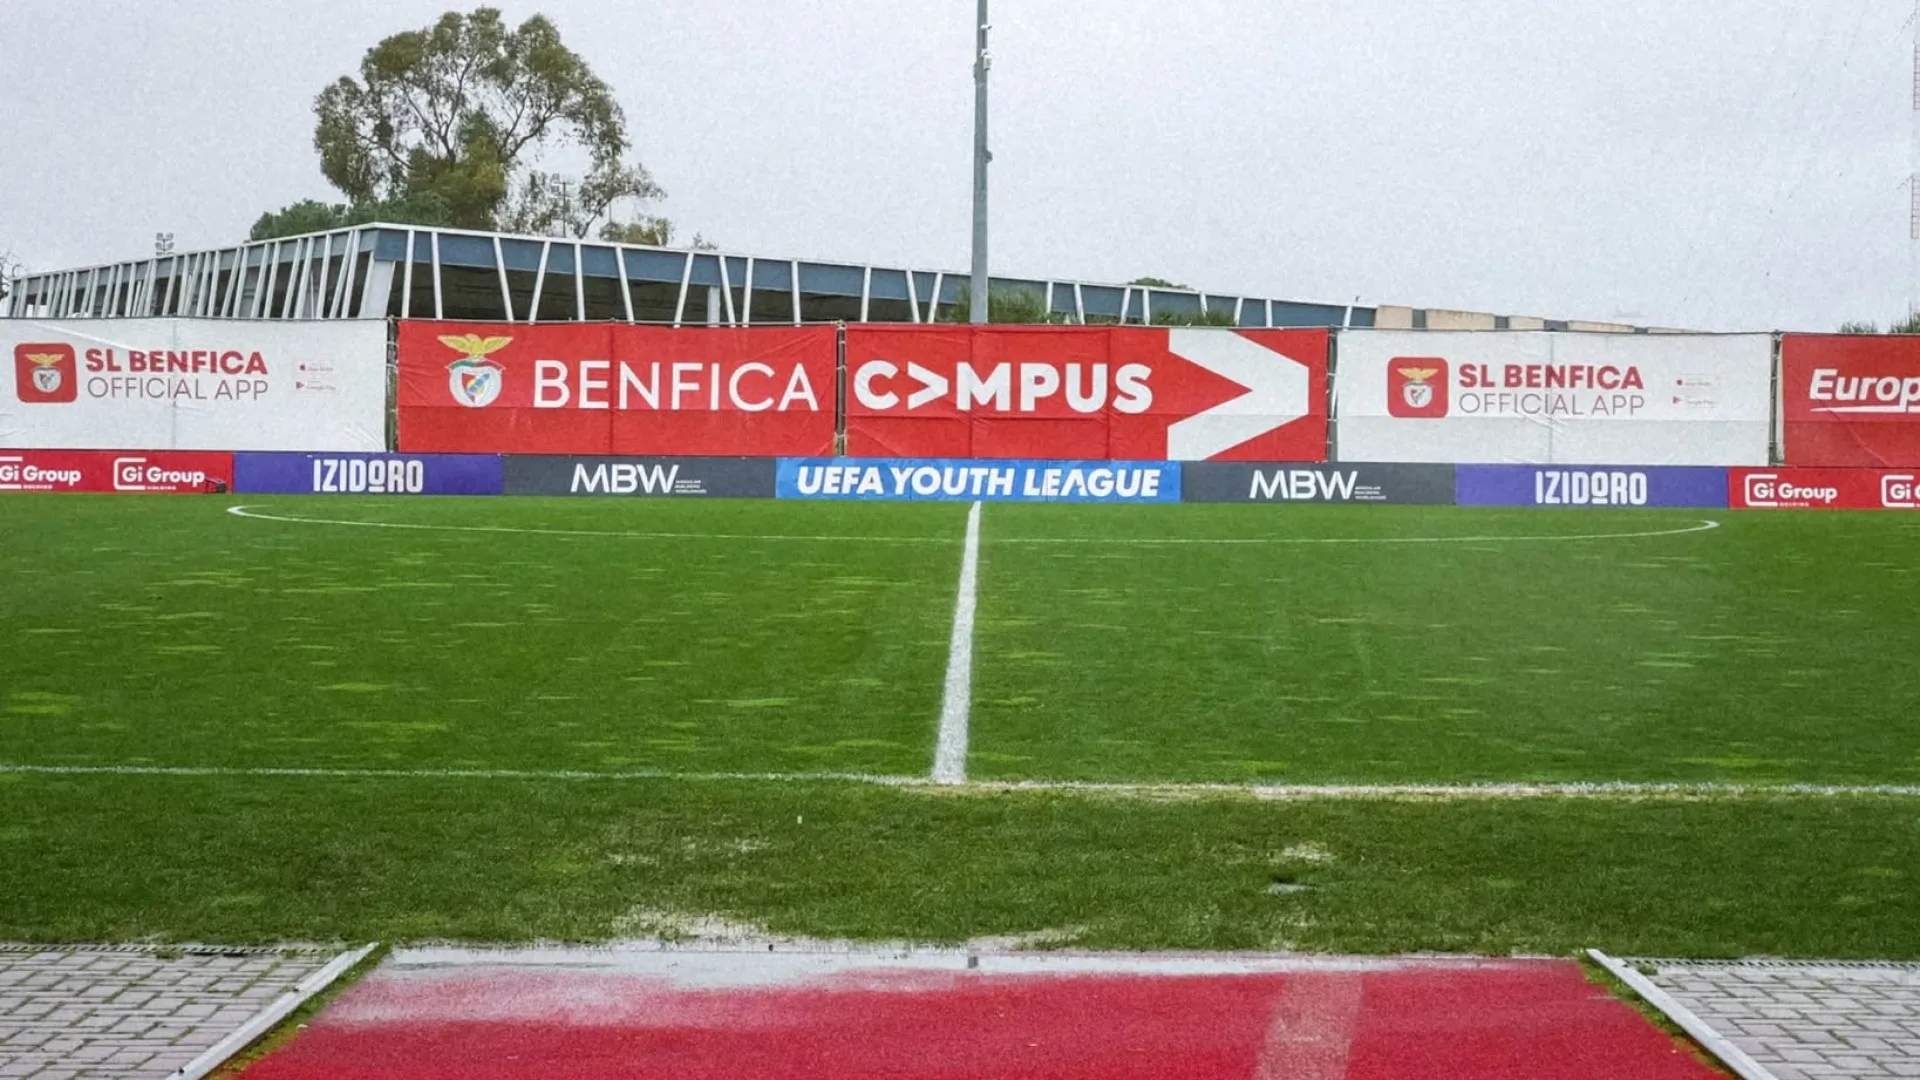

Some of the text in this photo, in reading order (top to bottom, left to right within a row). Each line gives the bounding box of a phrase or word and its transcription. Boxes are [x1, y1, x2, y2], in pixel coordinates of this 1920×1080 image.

[85, 348, 268, 375] SL BENFICA
[87, 377, 269, 401] OFFICIAL APP
[534, 360, 819, 411] BENFICA
[1459, 364, 1644, 390] SL BENFICA
[1458, 393, 1645, 416] OFFICIAL APP
[0, 465, 82, 486] Gi Group
[122, 466, 205, 488] Gi Group
[313, 459, 424, 493] IZIDORO
[570, 463, 679, 493] MBW
[797, 466, 1161, 497] UEFA YOUTH LEAGUE
[1249, 469, 1358, 500] MBW
[1535, 471, 1647, 505] IZIDORO
[1753, 482, 1838, 503] Gi Group
[1890, 483, 1911, 500] Gi
